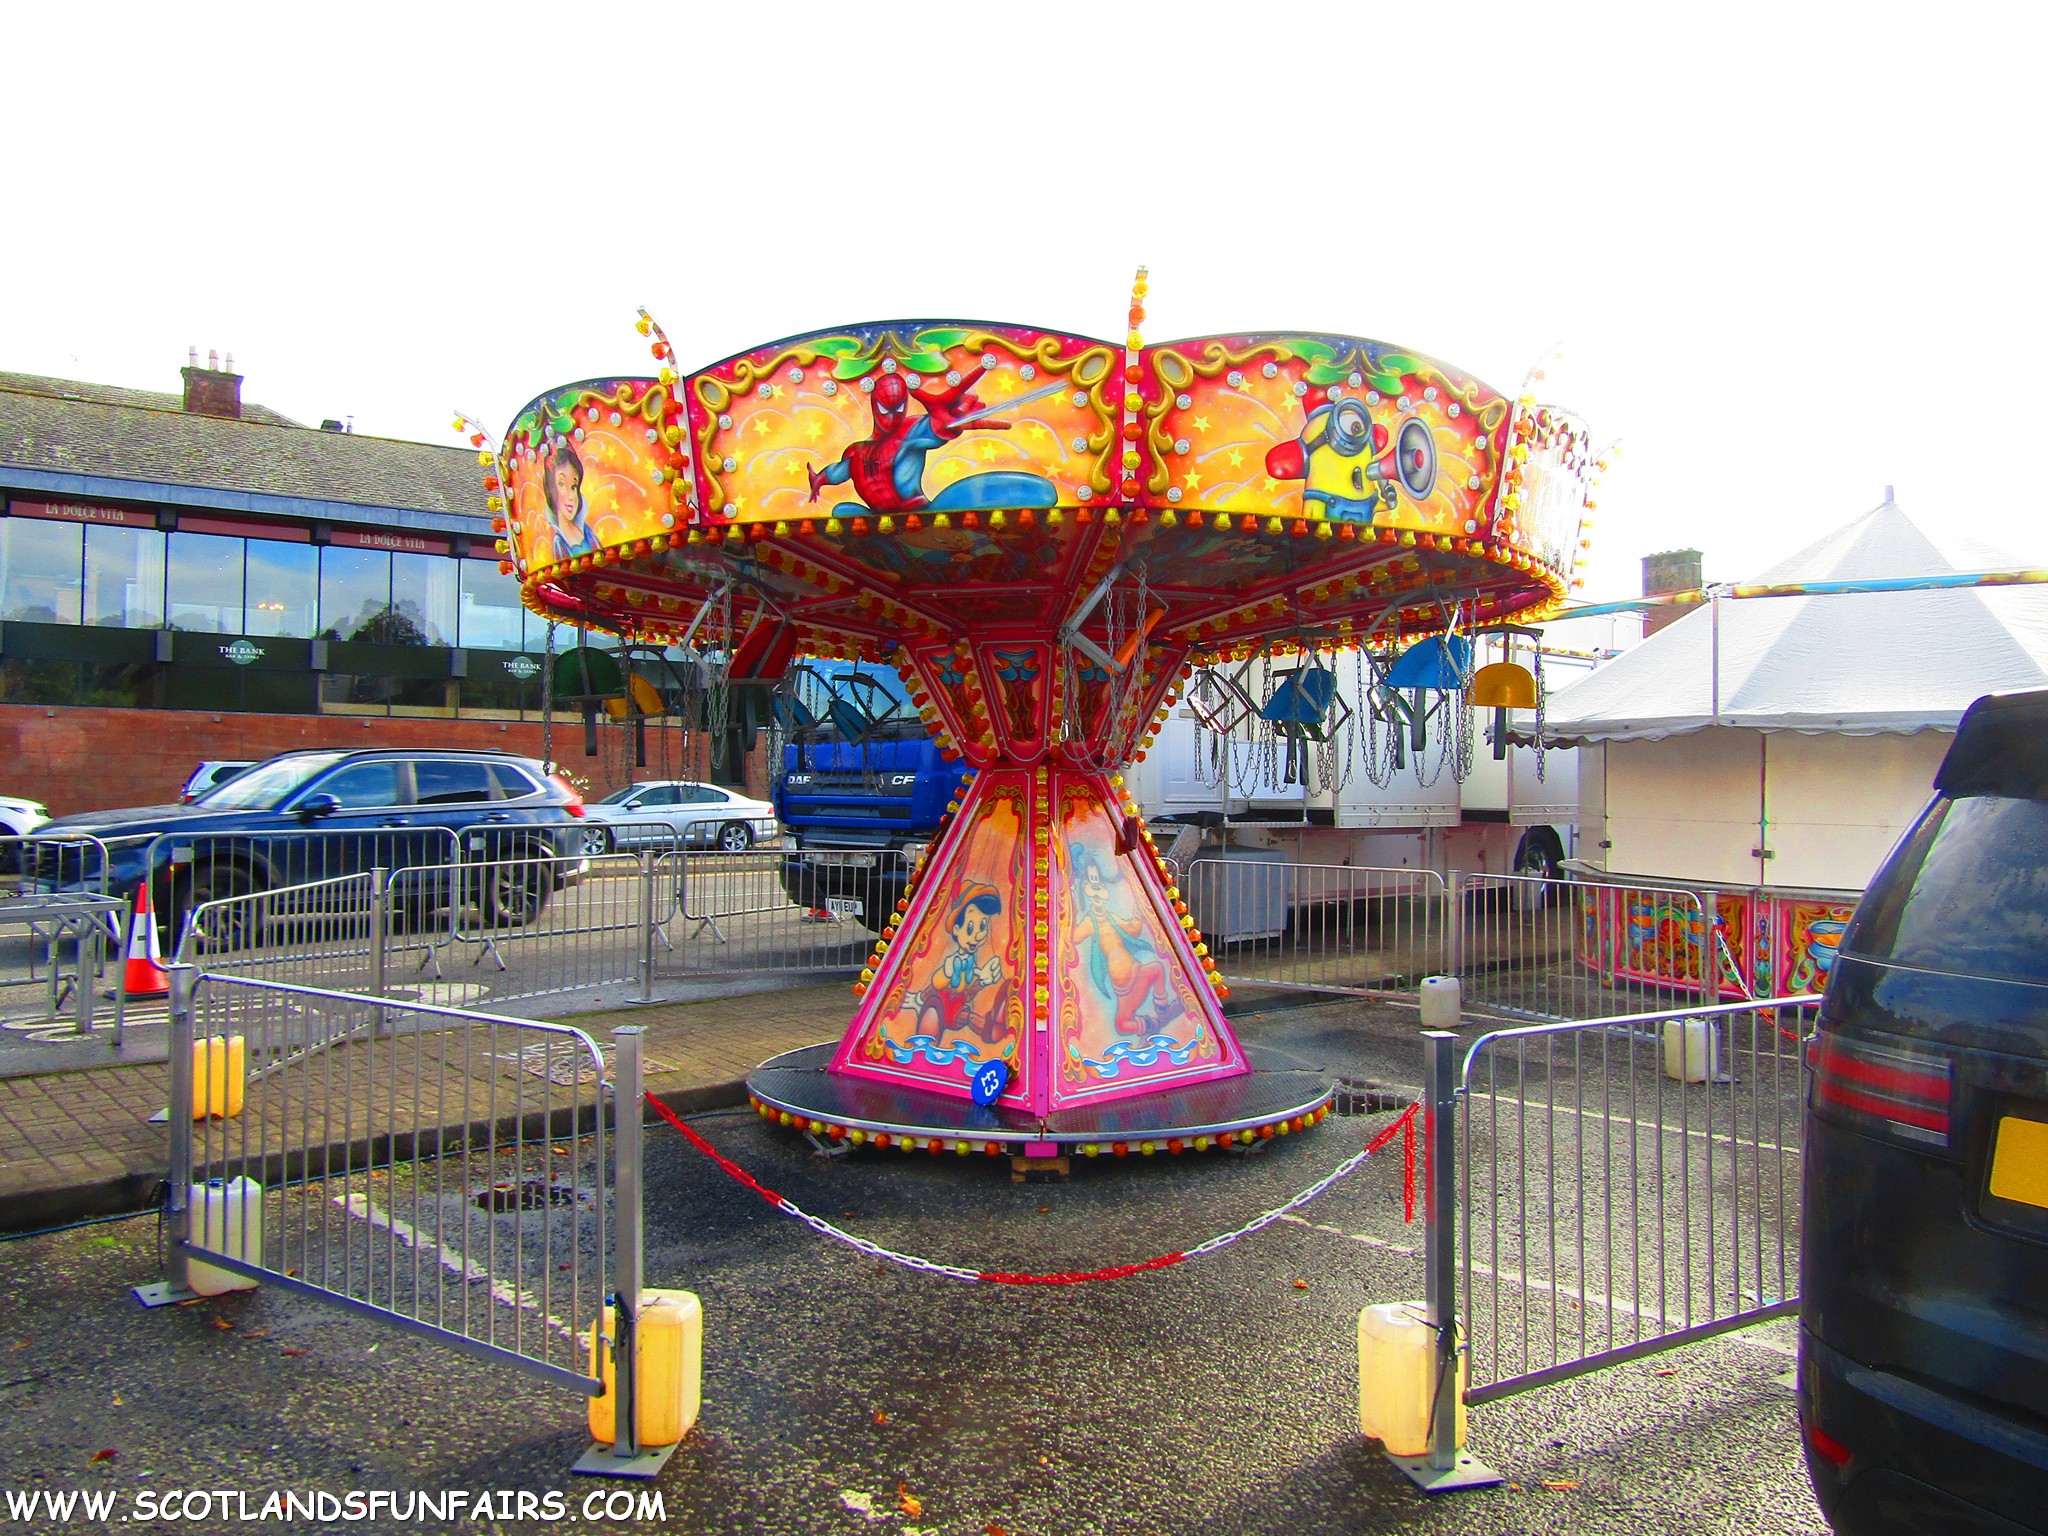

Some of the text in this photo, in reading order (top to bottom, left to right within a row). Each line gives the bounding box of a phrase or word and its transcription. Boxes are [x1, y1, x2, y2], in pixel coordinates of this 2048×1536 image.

[45, 503, 125, 520] LA DOLCE VITA
[360, 533, 425, 549] LA DOLCE VITA
[218, 646, 266, 655] THE BANK
[502, 661, 542, 671] THE BANK
[787, 775, 812, 785] DAF
[891, 775, 916, 785] CF
[980, 1069, 999, 1097] £3
